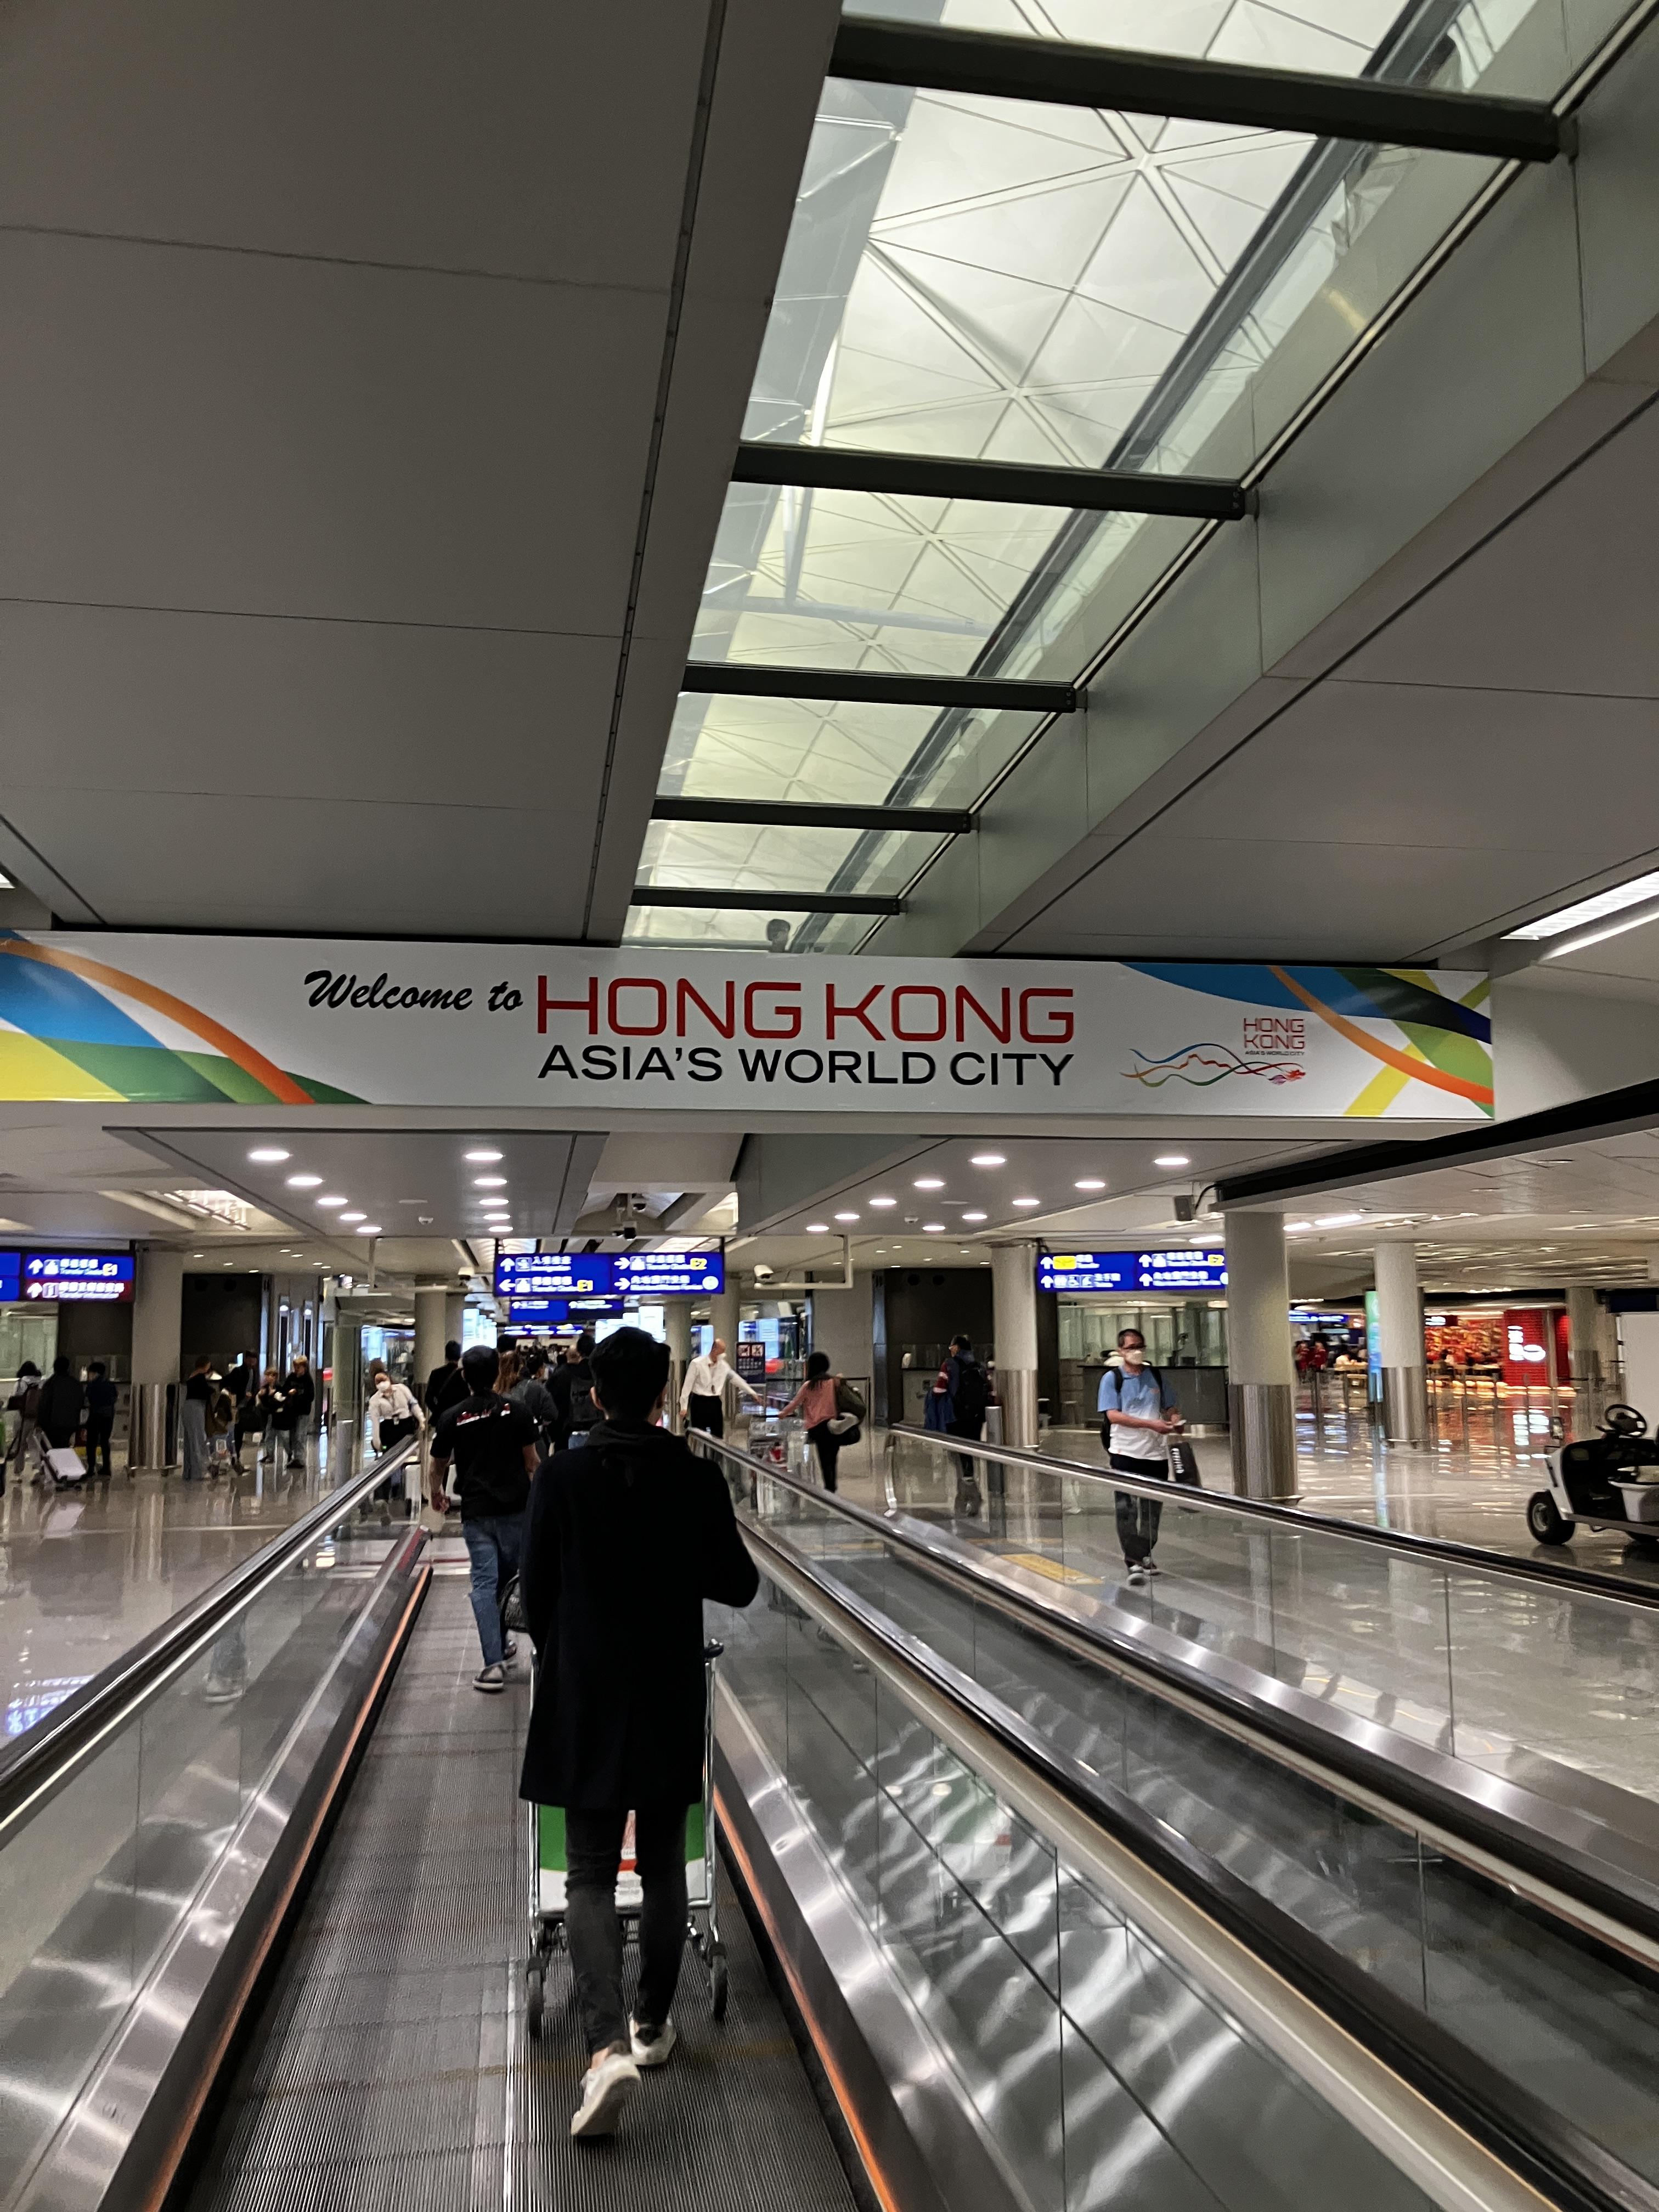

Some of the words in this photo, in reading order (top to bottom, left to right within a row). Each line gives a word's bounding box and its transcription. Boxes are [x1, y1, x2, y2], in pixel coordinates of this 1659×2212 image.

[304, 969, 473, 1010] Welcome
[488, 981, 523, 1012] to
[537, 975, 802, 1039] HONG
[826, 983, 1074, 1043] KONG
[1243, 1018, 1304, 1032] HONG
[1244, 1034, 1305, 1049] KONG
[537, 1045, 723, 1082] ASIA'S
[738, 1048, 936, 1084] WORLD
[950, 1052, 1075, 1086] CITY
